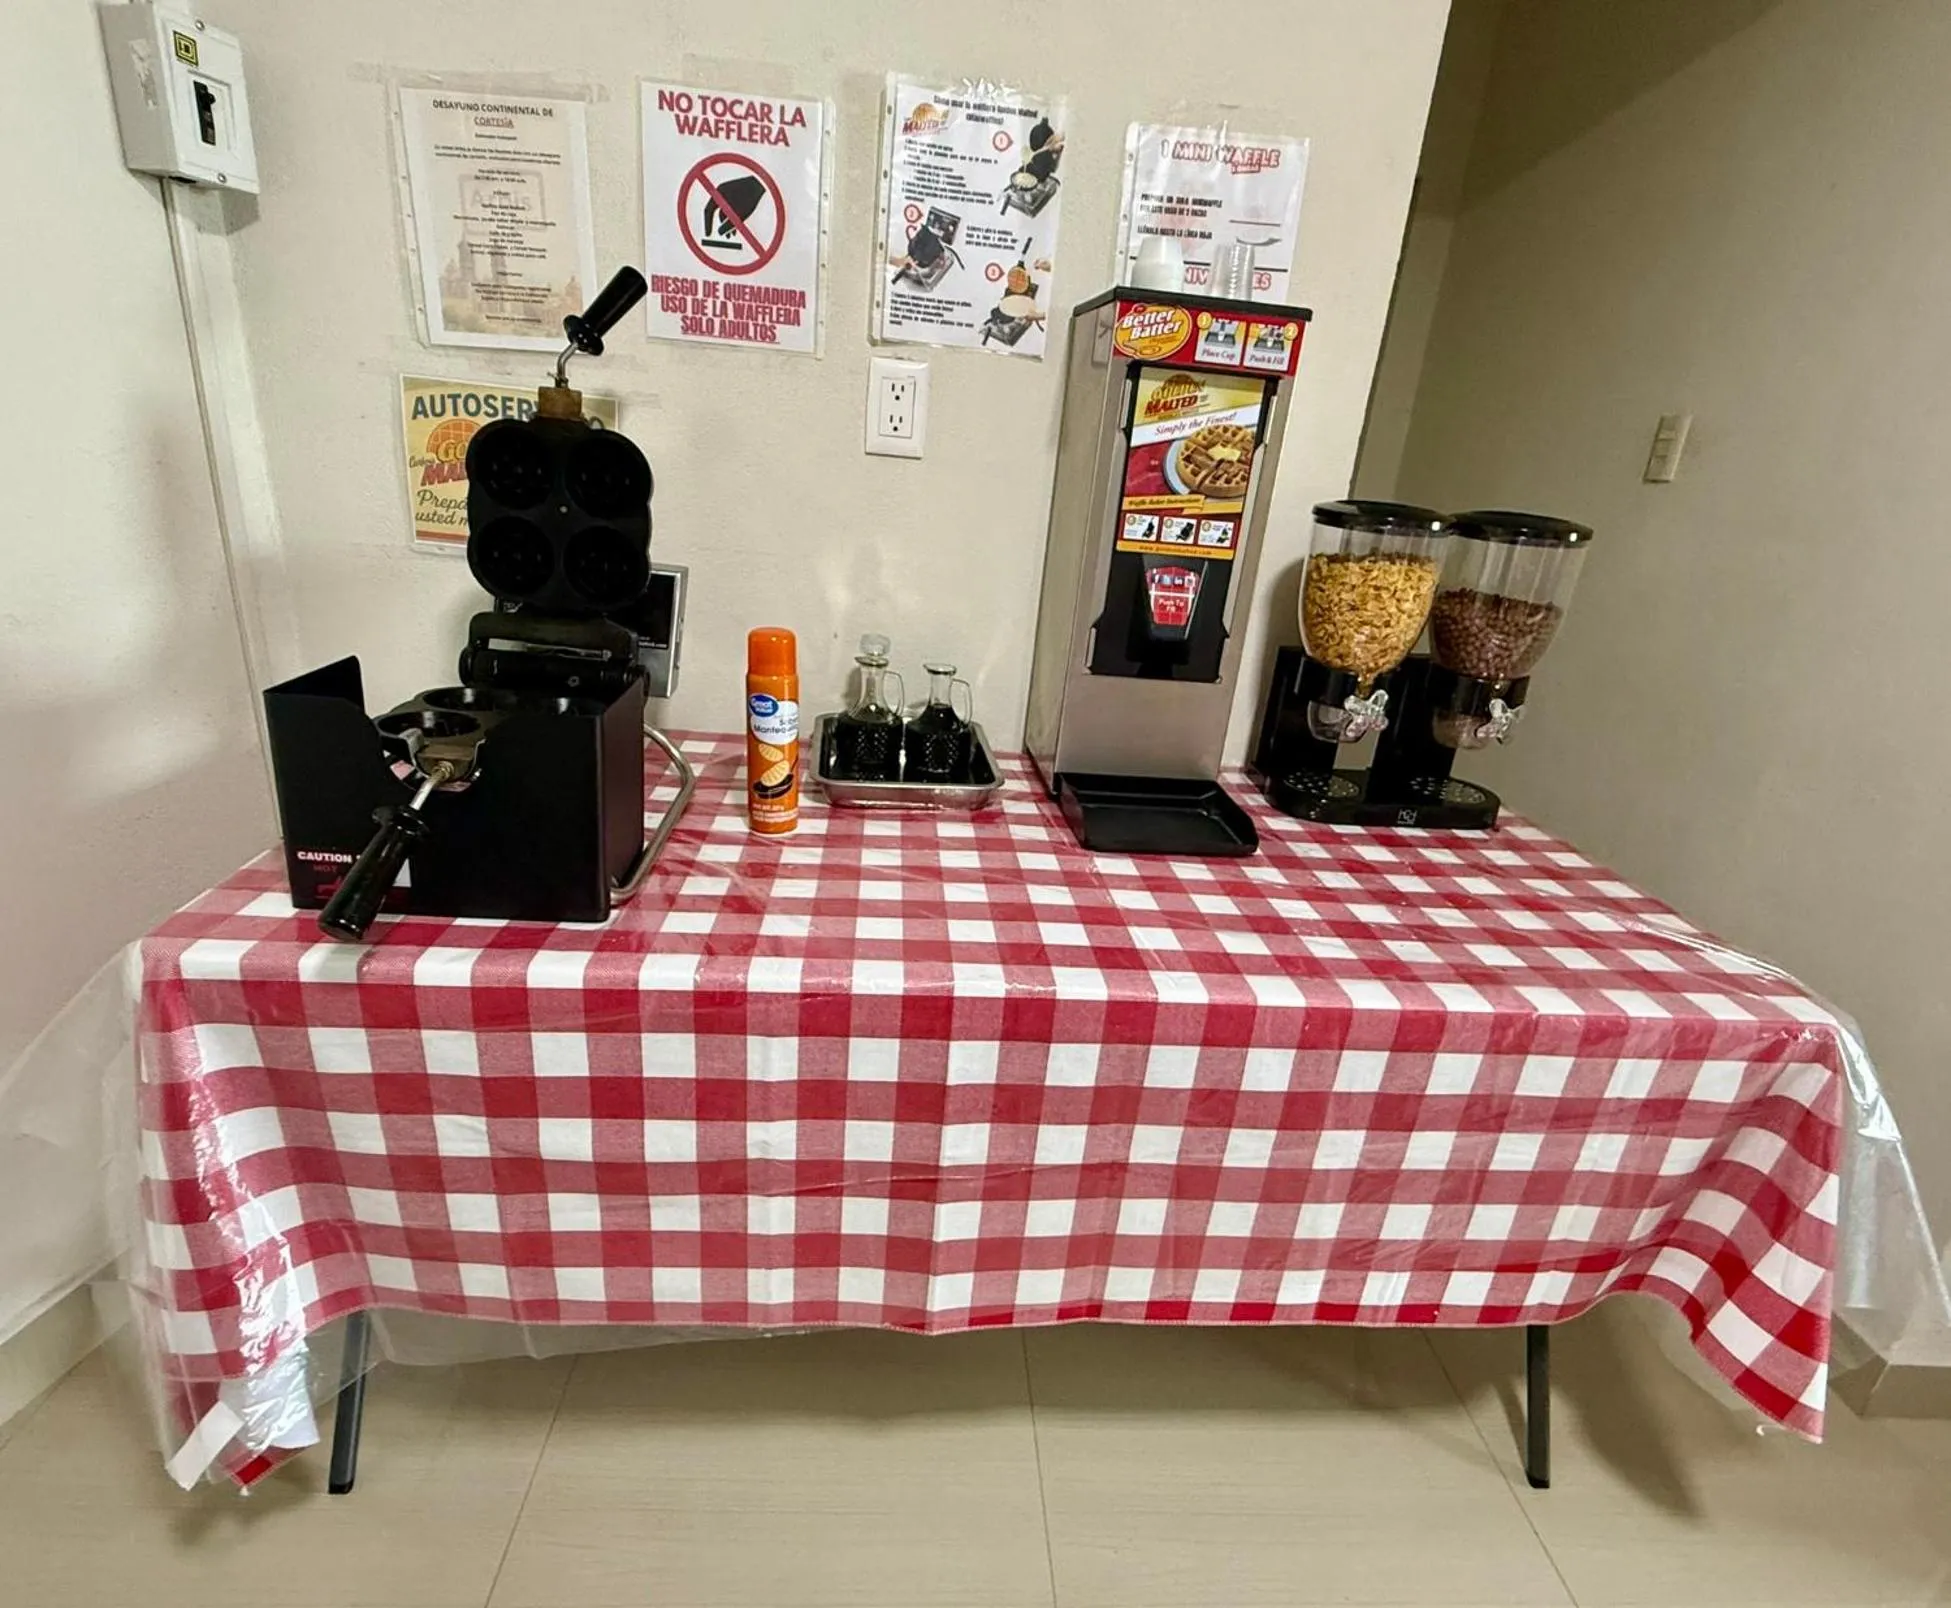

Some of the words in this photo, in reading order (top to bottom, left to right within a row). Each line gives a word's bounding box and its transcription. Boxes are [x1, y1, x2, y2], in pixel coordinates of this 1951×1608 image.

[432, 100, 479, 112] DESAYUNO
[481, 104, 540, 117] CONTINENTAL
[542, 107, 553, 117] DE
[658, 90, 692, 114] NO
[698, 95, 774, 123] TOCAR
[780, 105, 806, 128] LA
[674, 114, 790, 147] WAFFLERA
[1172, 141, 1212, 162] MINI
[1216, 144, 1281, 168] WAFFLE
[651, 275, 698, 296] RIESGO
[702, 280, 720, 299] DE
[723, 283, 806, 309] QUEMADURA
[660, 294, 687, 313] USO
[692, 297, 708, 316] DE
[712, 301, 728, 318] LA
[733, 302, 801, 326] WAFFLERA
[1122, 310, 1175, 328] Better
[681, 315, 714, 335] SOLO
[719, 320, 777, 342] ADULTOS
[1130, 321, 1182, 339] Batter
[411, 392, 537, 421] AUTOSER
[1145, 395, 1198, 416] MALTED
[1155, 421, 1187, 436] Simply
[1189, 418, 1203, 429] the
[1205, 412, 1238, 426] Finest!
[436, 440, 466, 464] GO
[420, 461, 466, 487] MAL
[417, 489, 467, 513] Prepa
[415, 510, 456, 525] usted
[296, 851, 353, 864] CAUTION
